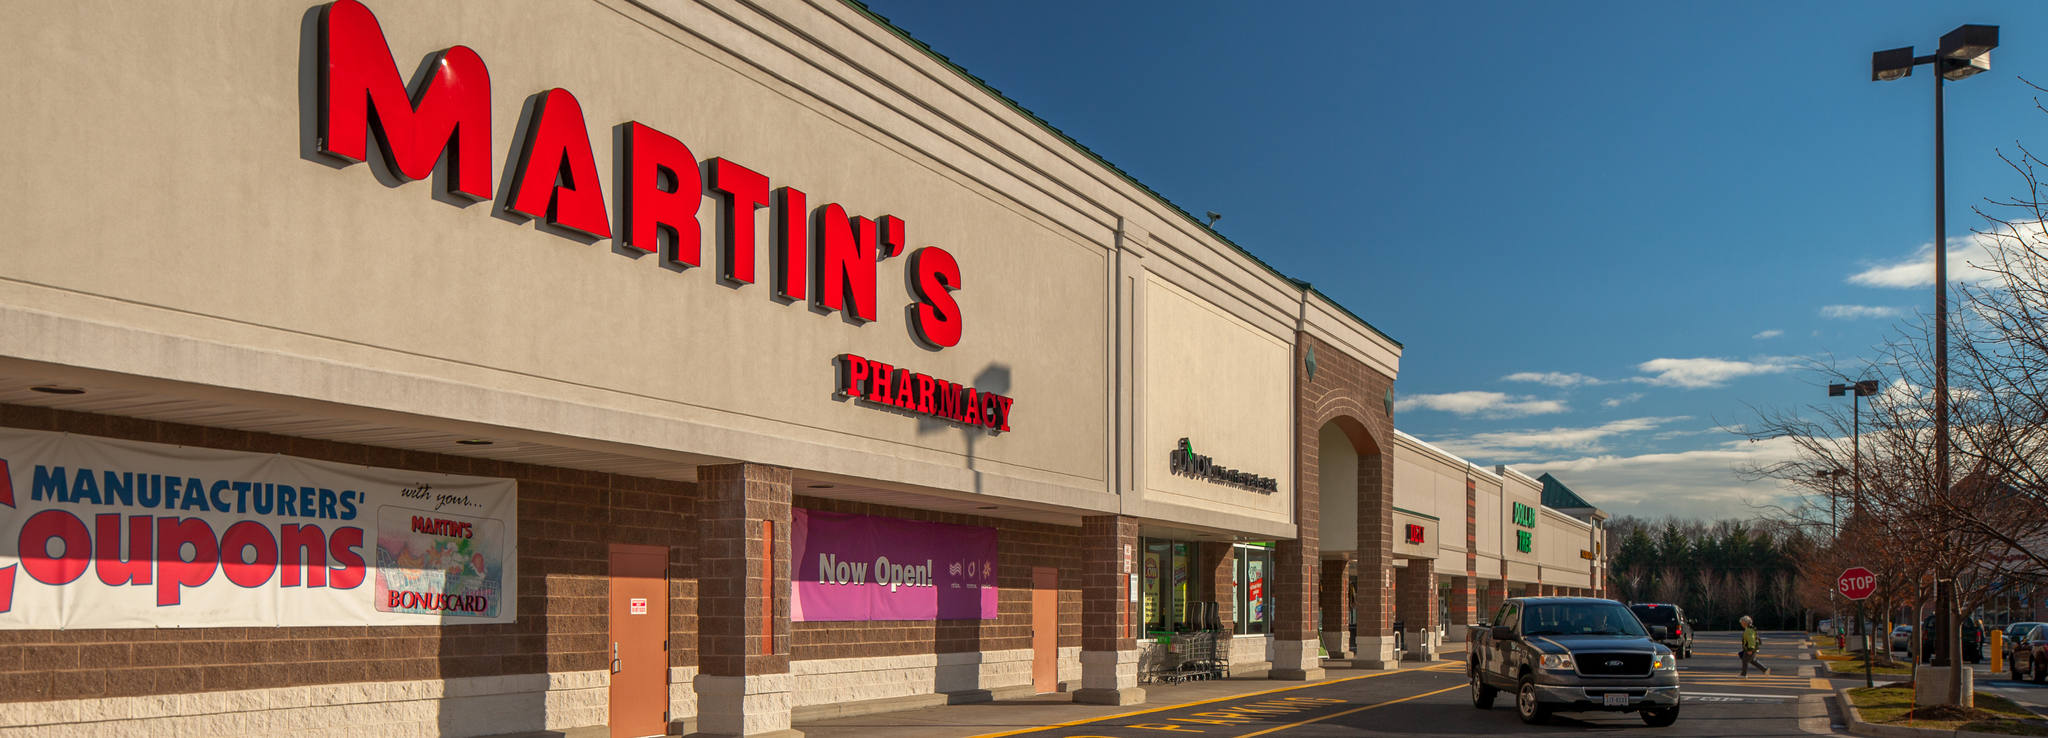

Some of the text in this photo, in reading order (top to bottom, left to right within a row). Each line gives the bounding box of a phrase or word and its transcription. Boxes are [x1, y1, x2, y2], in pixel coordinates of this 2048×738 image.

[318, 0, 963, 350] MARTIN'S
[840, 354, 1014, 433] PHARMACY
[31, 465, 365, 520] MANUFACTURERS'
[401, 482, 482, 511] with your...
[411, 515, 473, 539] MARTIN'S
[1513, 501, 1536, 529] DOLLAR
[0, 458, 366, 613] oupons
[819, 552, 933, 593] Now Open!
[1840, 575, 1873, 592] STOP
[387, 589, 488, 613] BONUSCARD
[1124, 697, 1349, 733] PARKING
